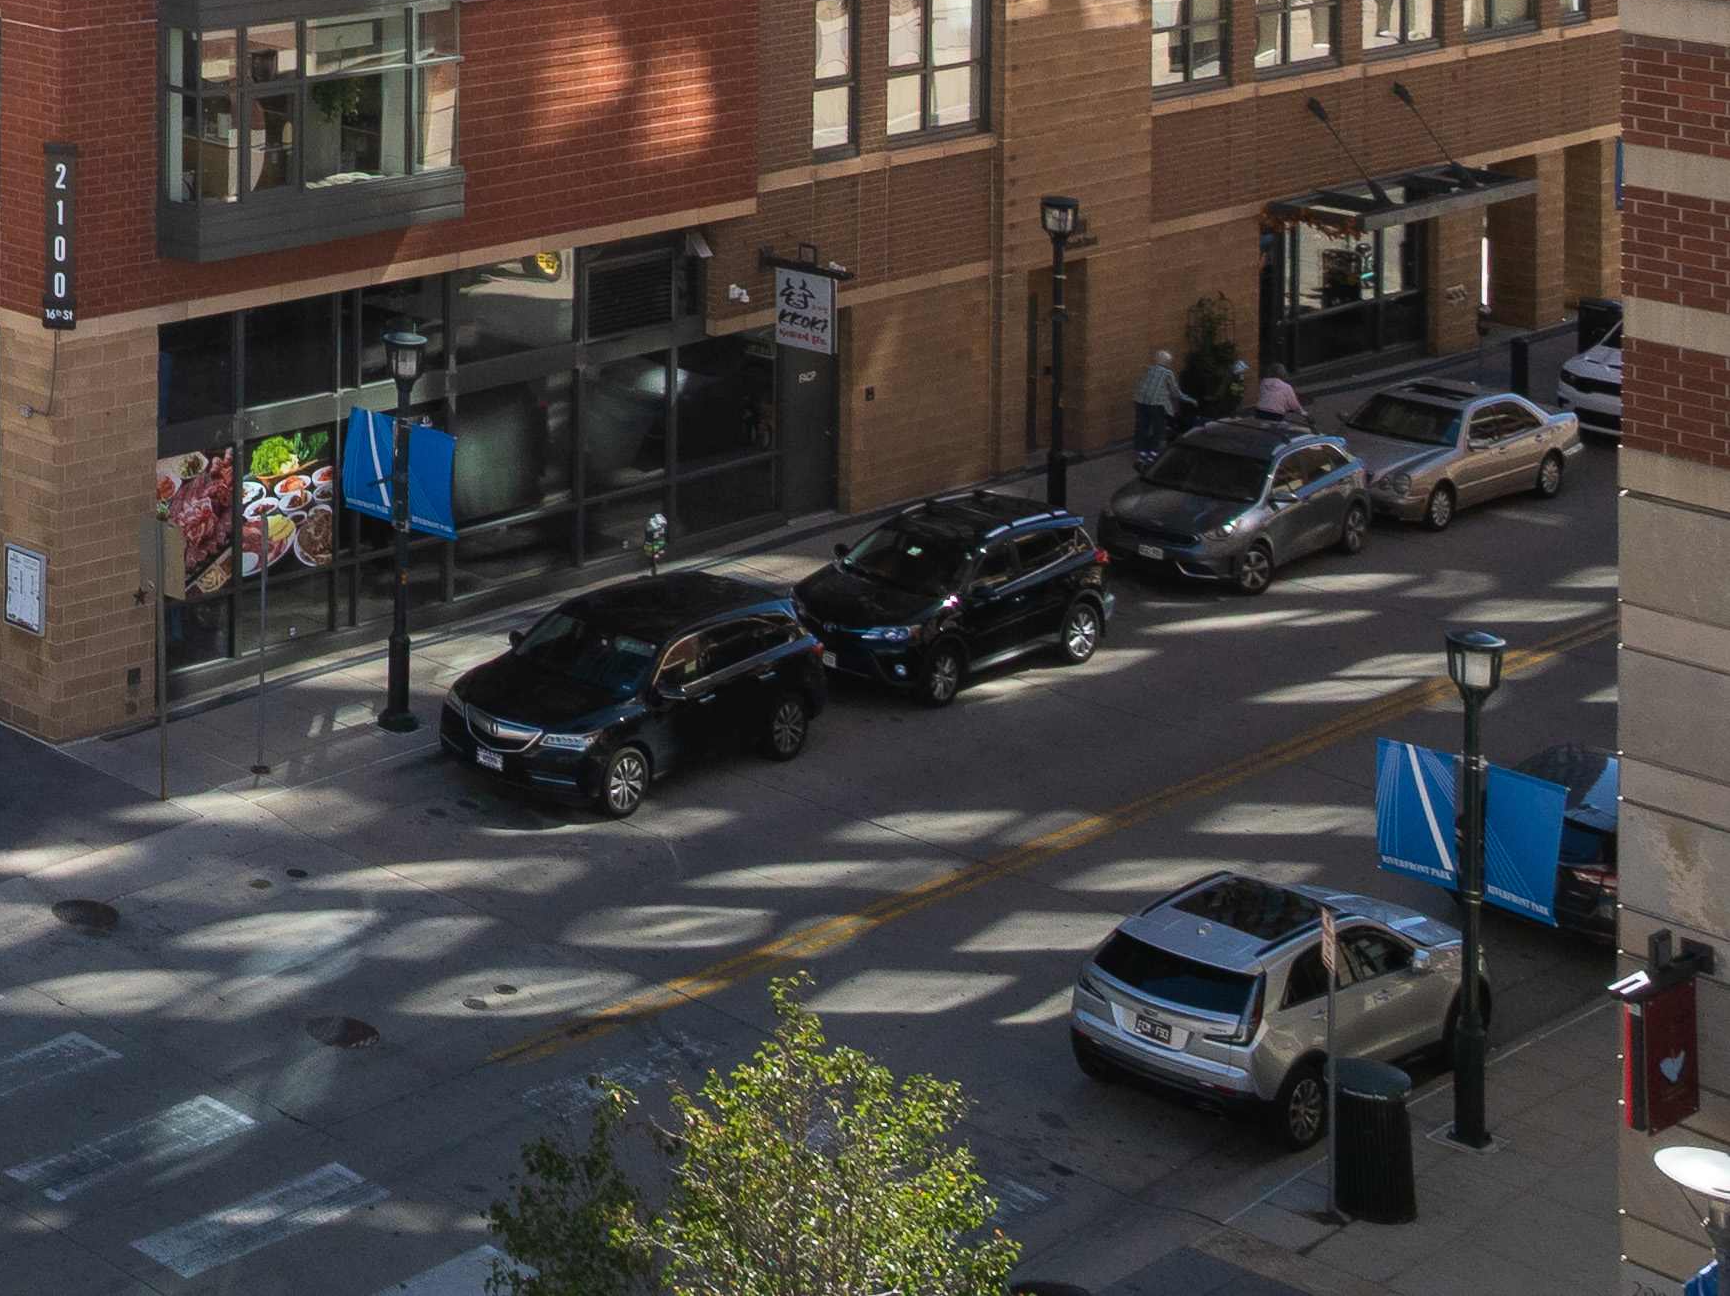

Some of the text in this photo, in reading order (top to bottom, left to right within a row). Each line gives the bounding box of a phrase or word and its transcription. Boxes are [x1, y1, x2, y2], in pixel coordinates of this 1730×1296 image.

[54, 163, 67, 298] 2100
[1381, 854, 1452, 881] RIVERFRONT PARK
[1487, 883, 1550, 917] RIVERFRONT PARK
